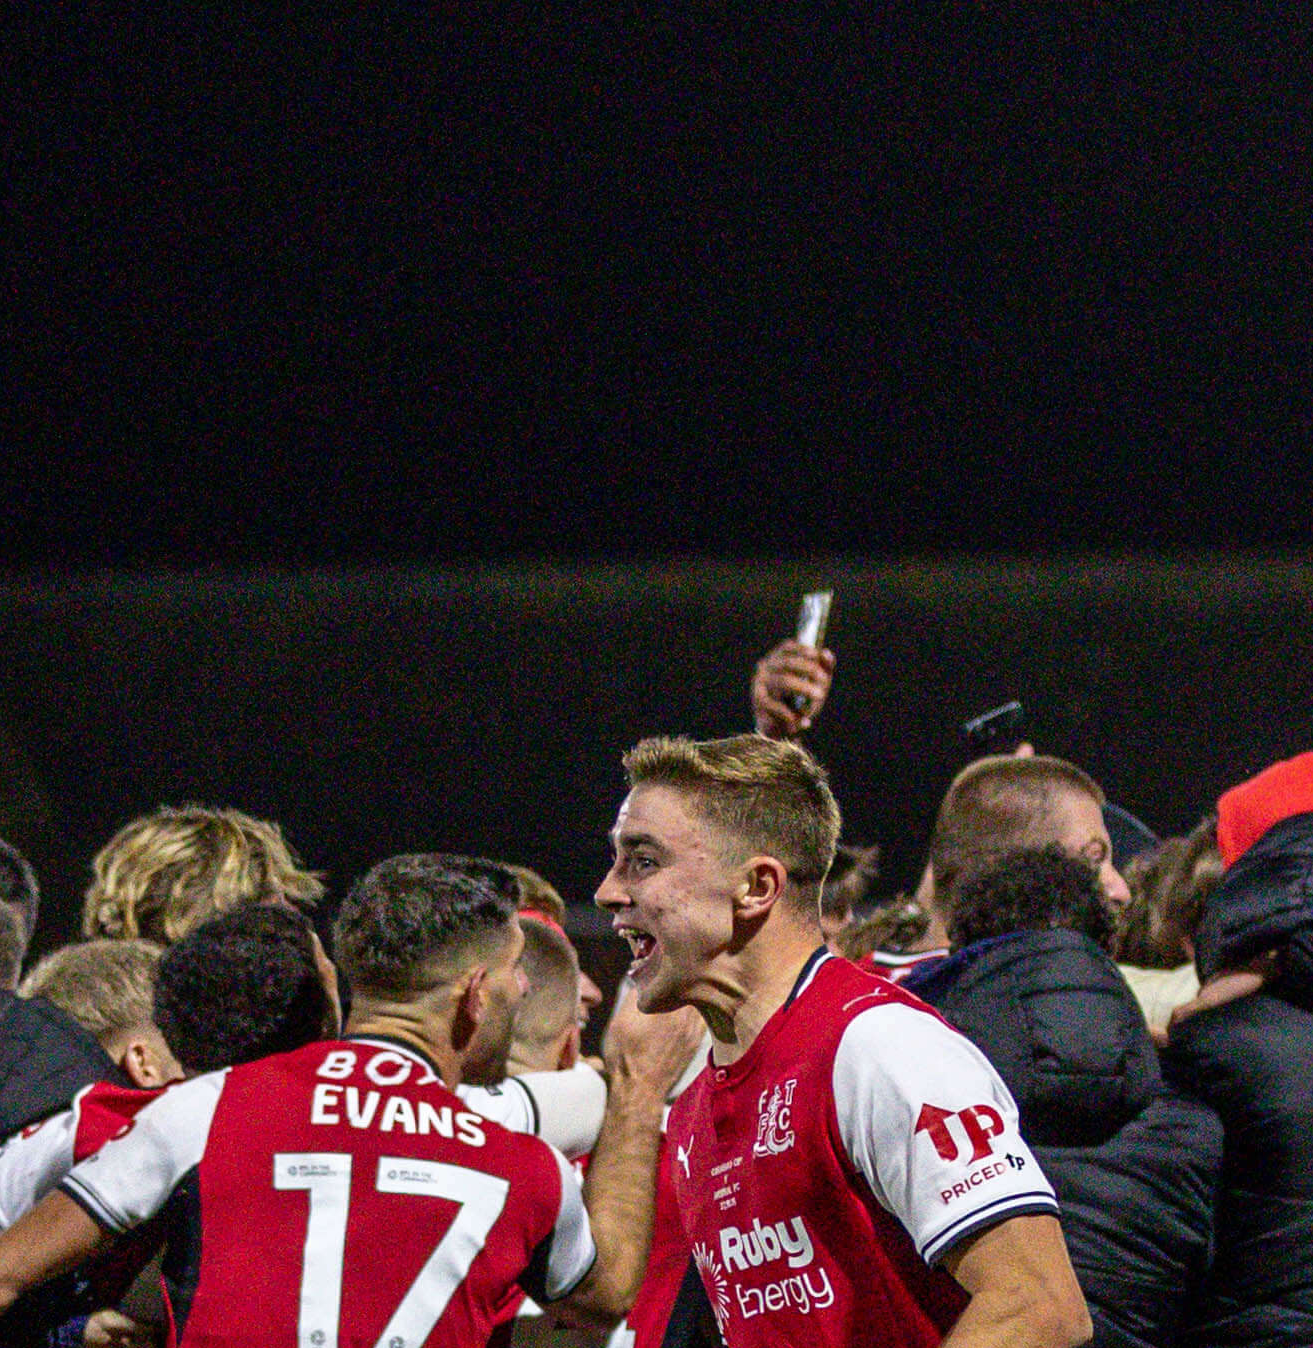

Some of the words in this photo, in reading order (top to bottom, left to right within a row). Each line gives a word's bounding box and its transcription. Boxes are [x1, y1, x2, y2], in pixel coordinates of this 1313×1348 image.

[310, 1083, 486, 1148] EVANS
[940, 1161, 1007, 1206] PRICED
[719, 1215, 815, 1274] Ruby
[735, 1267, 835, 1319] Energy
